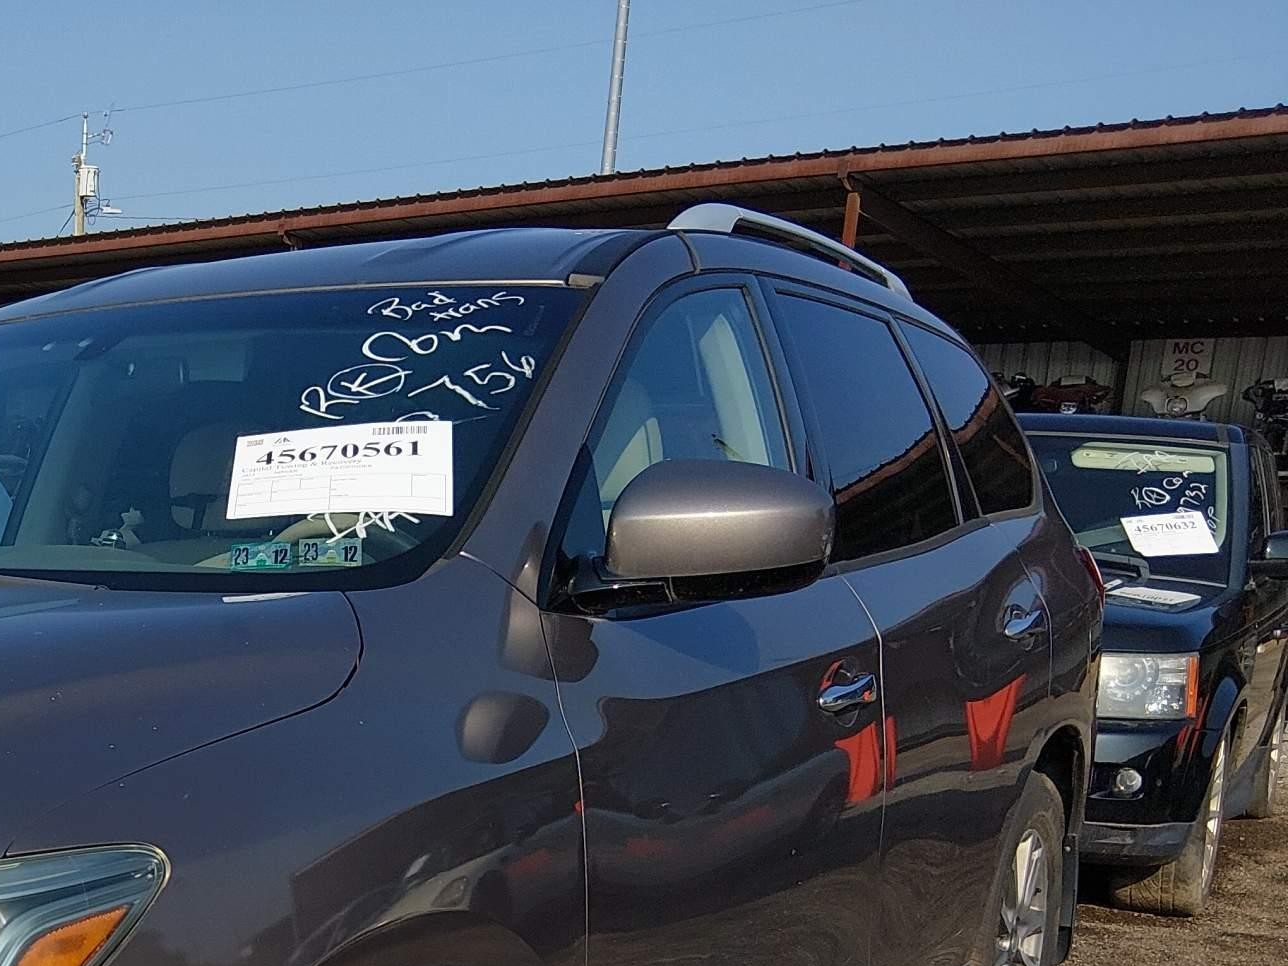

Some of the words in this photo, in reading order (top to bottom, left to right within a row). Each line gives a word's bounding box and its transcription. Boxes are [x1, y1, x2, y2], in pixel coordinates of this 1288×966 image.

[367, 291, 457, 320] Bad
[1173, 341, 1205, 354] MC
[1174, 359, 1200, 371] 20
[255, 440, 423, 465] 45670561
[1134, 521, 1197, 534] 45670632
[235, 548, 249, 565] 23
[272, 548, 288, 564] 12
[303, 543, 319, 561] 23
[342, 546, 358, 562] 12
